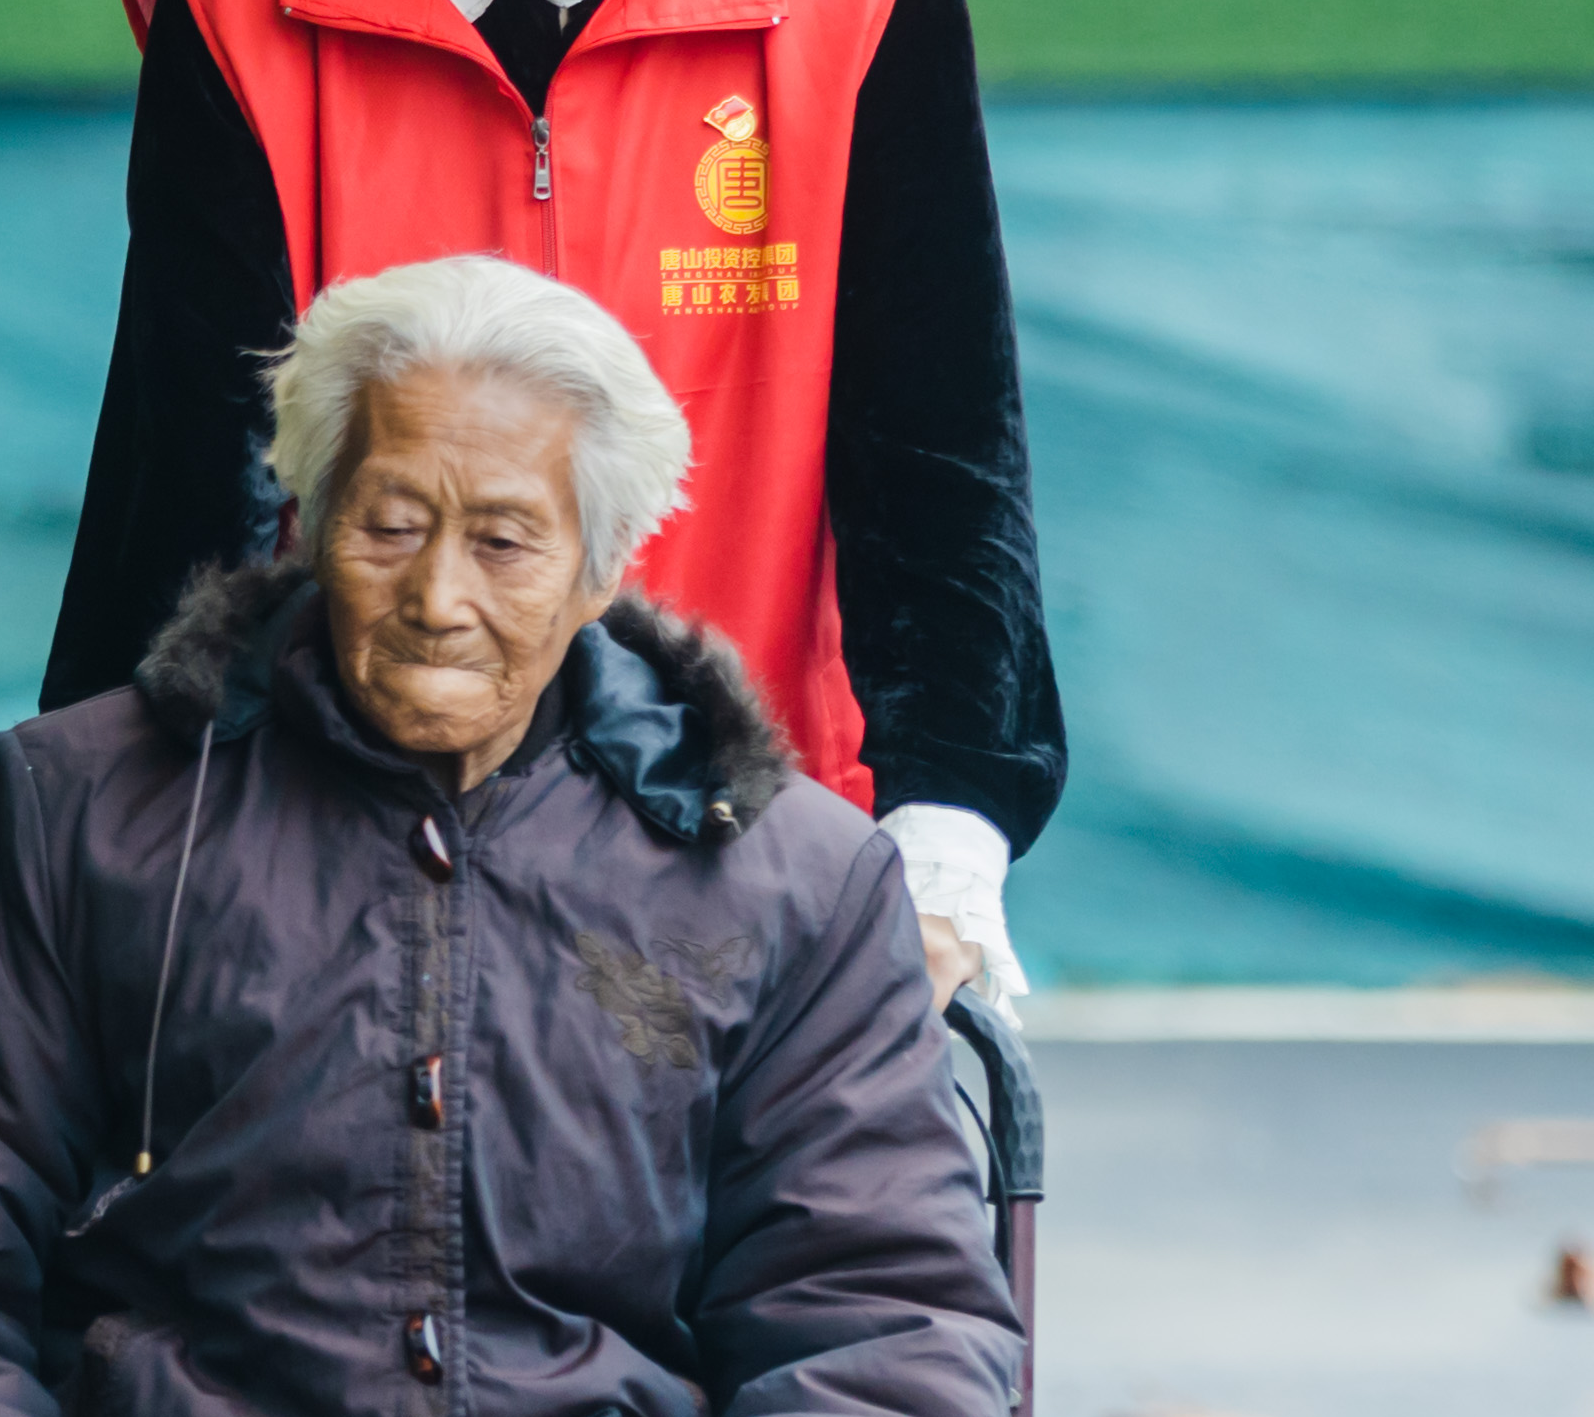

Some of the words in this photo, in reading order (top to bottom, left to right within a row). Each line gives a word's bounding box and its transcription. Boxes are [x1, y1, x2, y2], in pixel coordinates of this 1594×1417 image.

[660, 244, 797, 271] 唐山投资控集团
[661, 271, 743, 280] TANGSHAN
[662, 307, 743, 316] TANGSHAN
